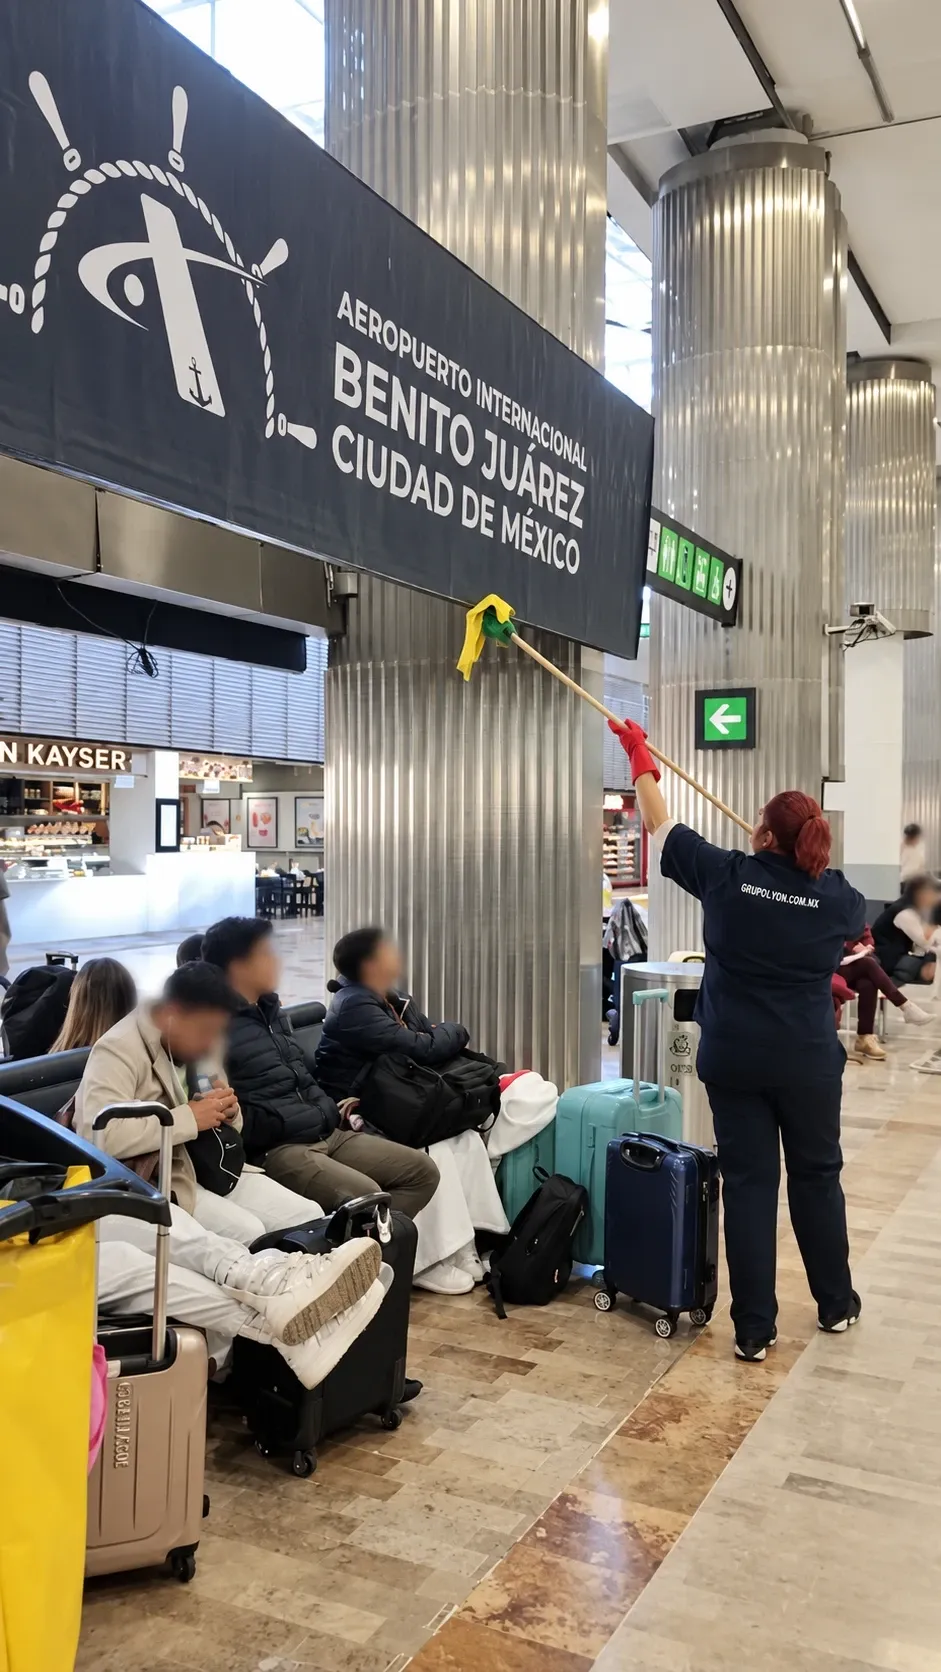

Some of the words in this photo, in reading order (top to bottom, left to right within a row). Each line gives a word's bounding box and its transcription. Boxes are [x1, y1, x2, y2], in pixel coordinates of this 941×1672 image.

[334, 341, 475, 467] BENITO
[481, 429, 585, 529] JUÁREZ
[337, 291, 472, 398] AEROPUERTO
[476, 378, 587, 472] INTERNACIONAL
[332, 424, 454, 517] CIUDAD
[461, 485, 495, 538] DE
[501, 506, 580, 575] MÉXICO
[27, 743, 126, 770] KAYSER
[740, 883, 820, 908] GRUPOLYON.COM.MX
